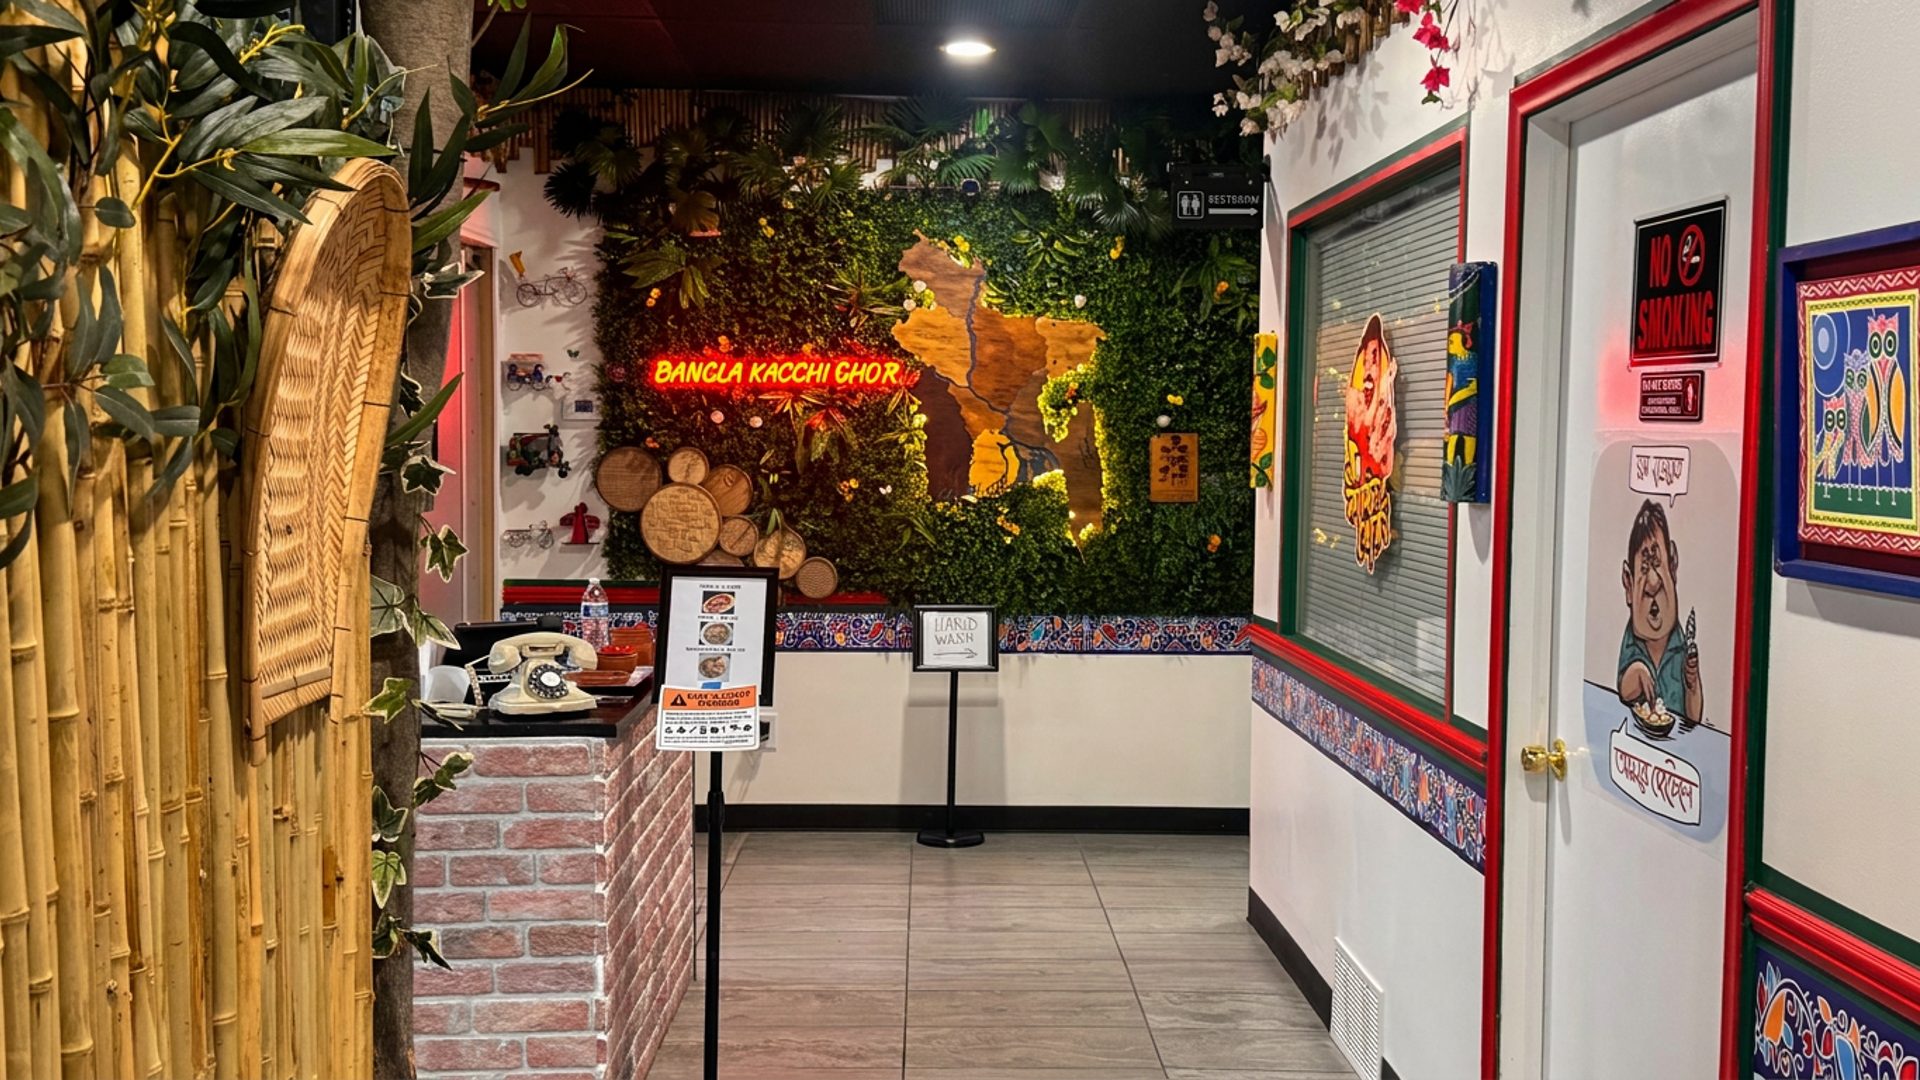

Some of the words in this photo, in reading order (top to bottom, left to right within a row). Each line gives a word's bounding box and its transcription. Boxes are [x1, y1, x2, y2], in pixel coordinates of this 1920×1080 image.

[1649, 234, 1672, 288] NO
[1637, 290, 1714, 350] SMOKING
[749, 362, 831, 384] KACCHI
[835, 361, 900, 385] GHOR
[935, 633, 974, 645] WASH
